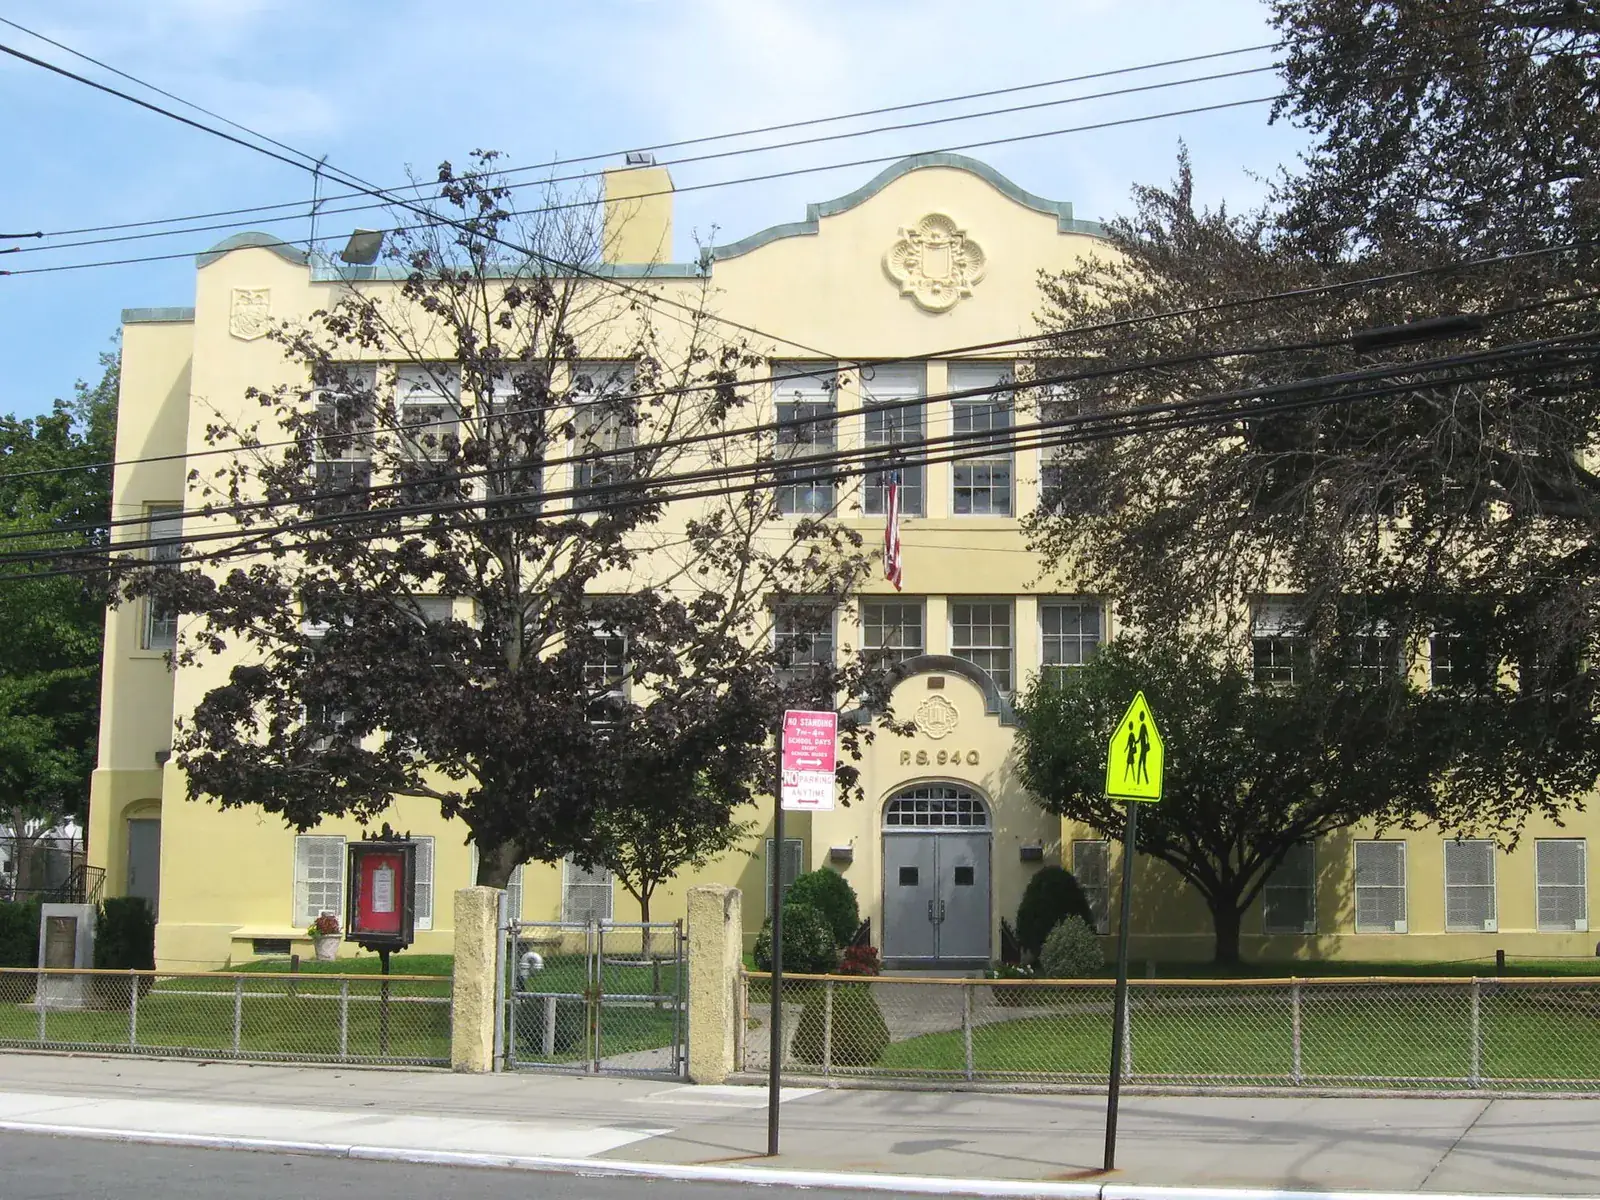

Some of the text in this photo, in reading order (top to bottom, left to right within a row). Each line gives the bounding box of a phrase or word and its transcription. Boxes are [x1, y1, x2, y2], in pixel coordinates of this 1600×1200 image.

[788, 718, 833, 727] NO STANDING
[788, 737, 832, 745] SCHOOL DAYS
[784, 772, 832, 784] NO PARKING
[792, 789, 825, 798] ANYTIME
